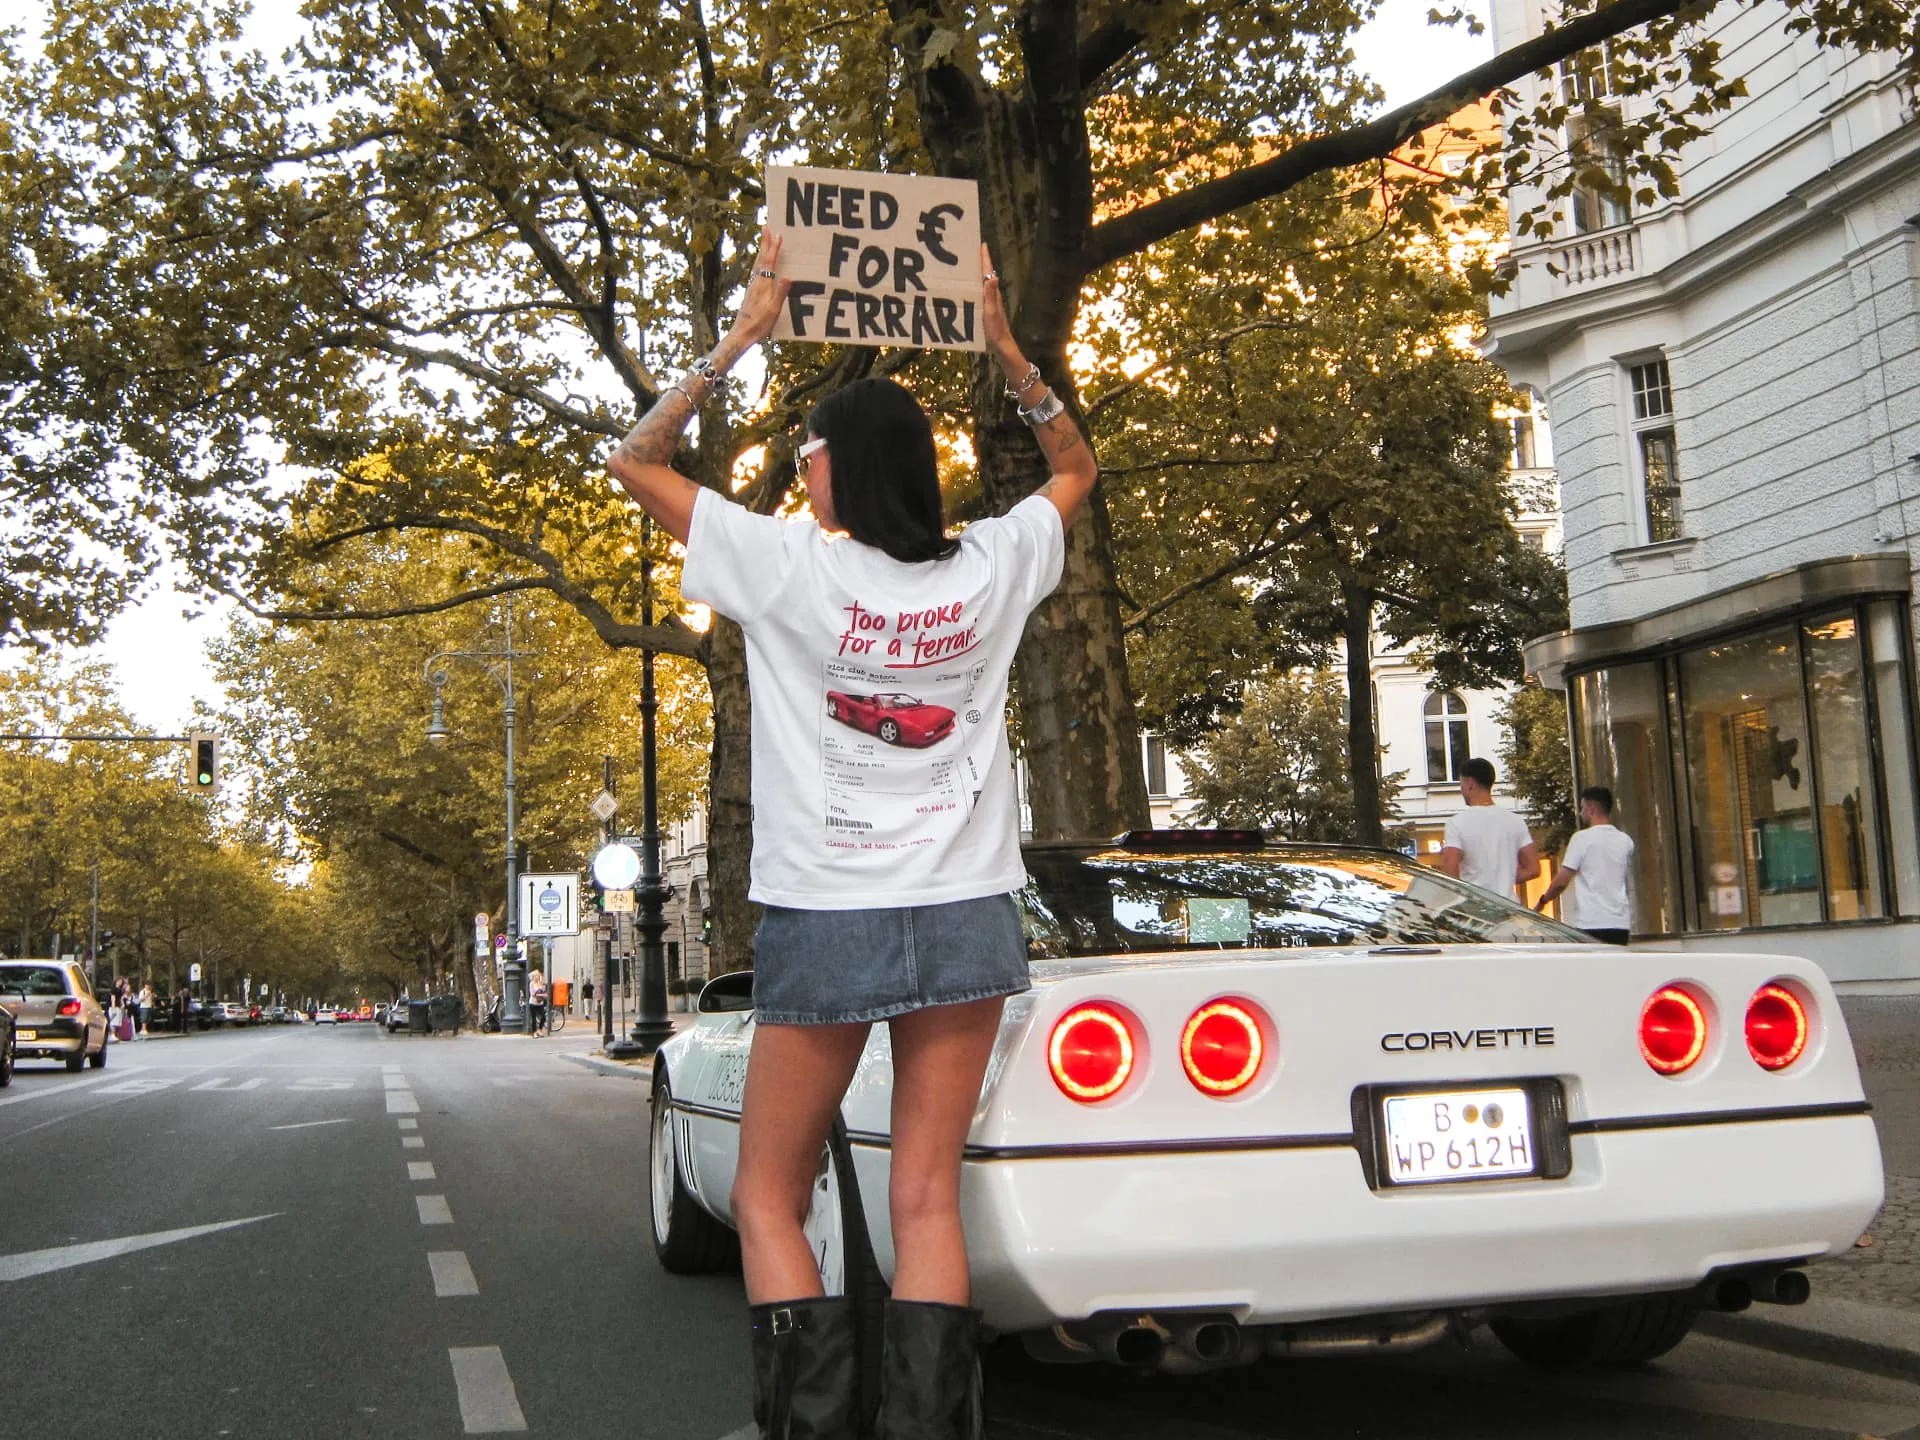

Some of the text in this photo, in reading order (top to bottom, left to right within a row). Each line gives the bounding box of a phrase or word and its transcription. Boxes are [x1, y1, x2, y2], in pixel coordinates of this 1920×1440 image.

[786, 177, 964, 266] NEED €
[829, 232, 928, 293] FOR
[787, 280, 975, 345] FERRARI
[843, 599, 963, 634] too broke
[839, 630, 877, 657] for
[887, 638, 901, 657] a
[830, 805, 849, 816] TOTAL
[1381, 1027, 1555, 1051] CORVETTE
[1434, 1102, 1452, 1132] B
[1395, 1133, 1529, 1174] WP 612H
